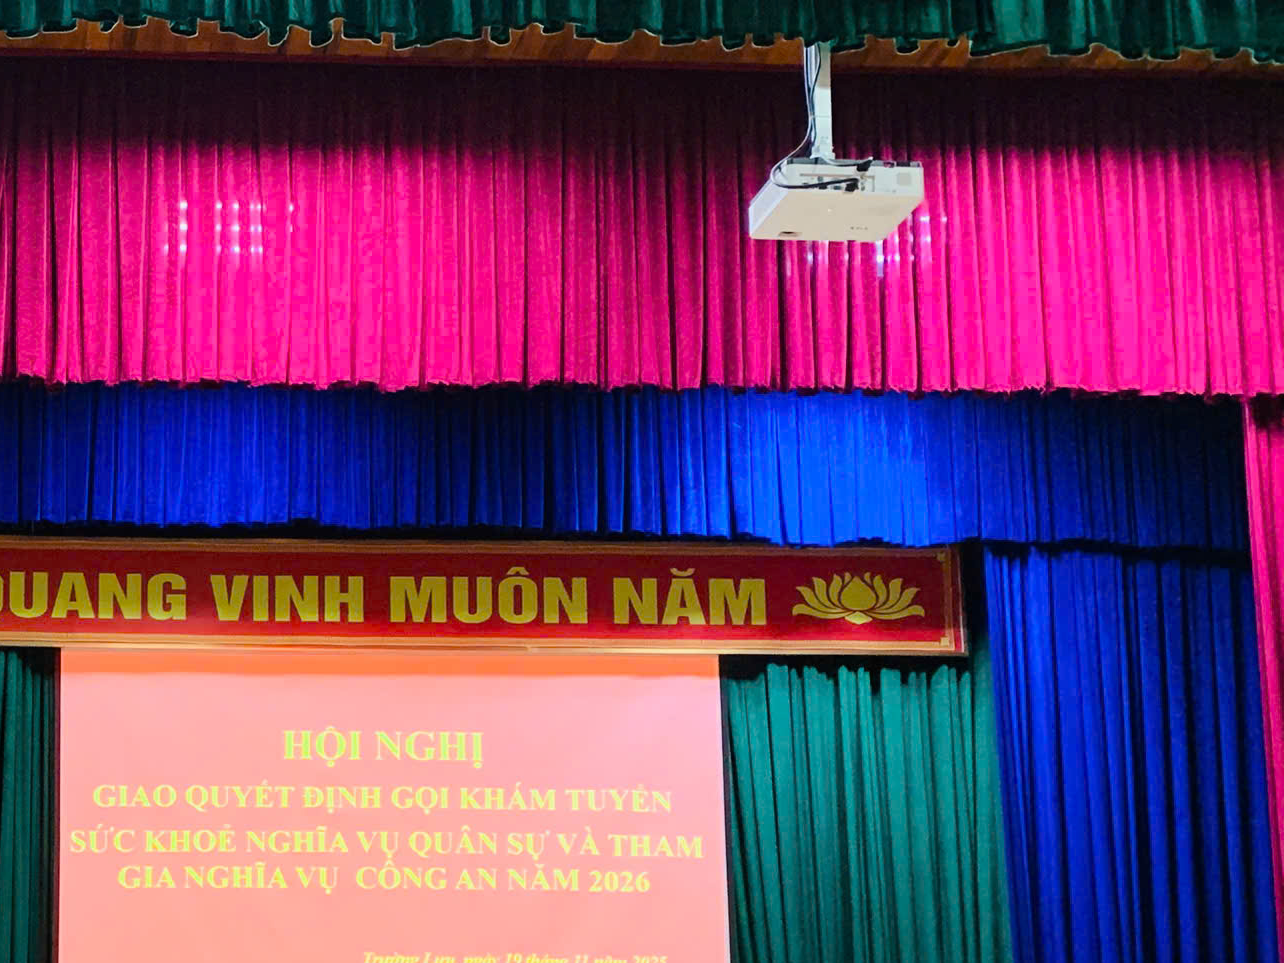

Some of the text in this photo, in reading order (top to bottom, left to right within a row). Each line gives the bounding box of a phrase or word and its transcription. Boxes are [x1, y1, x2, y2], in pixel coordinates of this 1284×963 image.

[210, 575, 364, 622] VINH
[390, 567, 588, 624] MUÔN
[613, 568, 766, 625] NĂM
[284, 726, 483, 768] HỘI NGHỊ
[93, 784, 177, 807] GIAO
[303, 786, 380, 813] ĐỊNH
[391, 786, 448, 814] GỌI
[460, 782, 556, 810] KHÁM
[70, 824, 135, 853] SỨC
[246, 826, 348, 853] NGHĨA
[356, 832, 398, 861] VỤ
[408, 825, 496, 857] QUÂN
[508, 830, 550, 860] SỰ
[557, 826, 598, 855] VÀ
[608, 834, 703, 858] THAM
[118, 860, 650, 894] GIA NGHĨA VỤ CÔNG AN NĂM 2026
